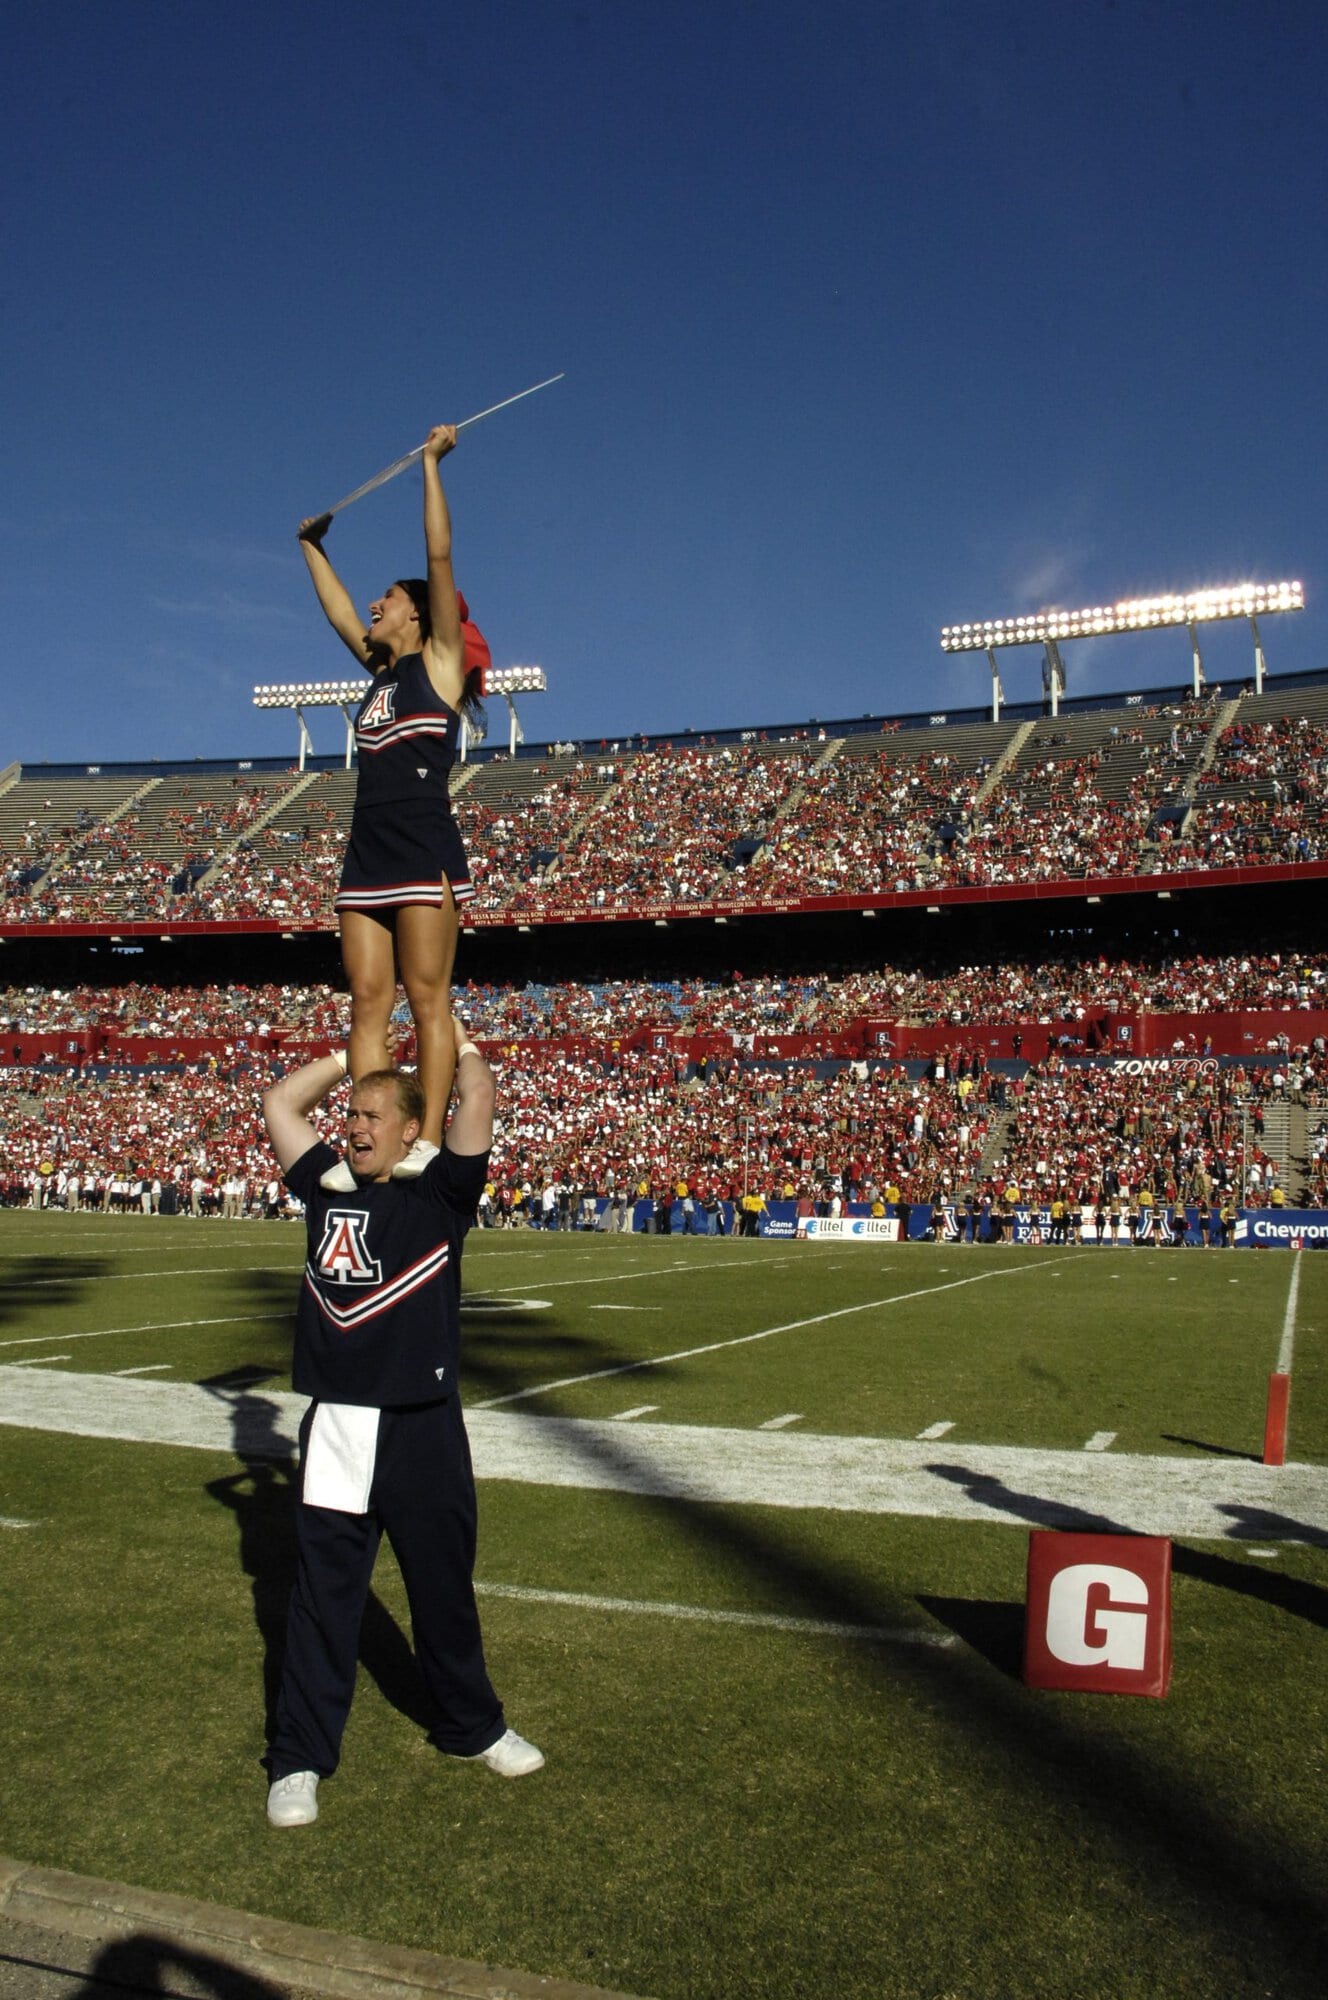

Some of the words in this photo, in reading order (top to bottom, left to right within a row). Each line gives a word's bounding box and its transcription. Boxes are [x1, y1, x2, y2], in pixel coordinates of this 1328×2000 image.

[1126, 696, 1143, 704] 207
[359, 683, 398, 731] A
[764, 1226, 797, 1235] Sponsor
[770, 1220, 793, 1228] Game
[1253, 1221, 1328, 1239] Chevron
[316, 1209, 383, 1285] A
[1291, 1240, 1299, 1249] G
[1046, 1564, 1149, 1671] G
